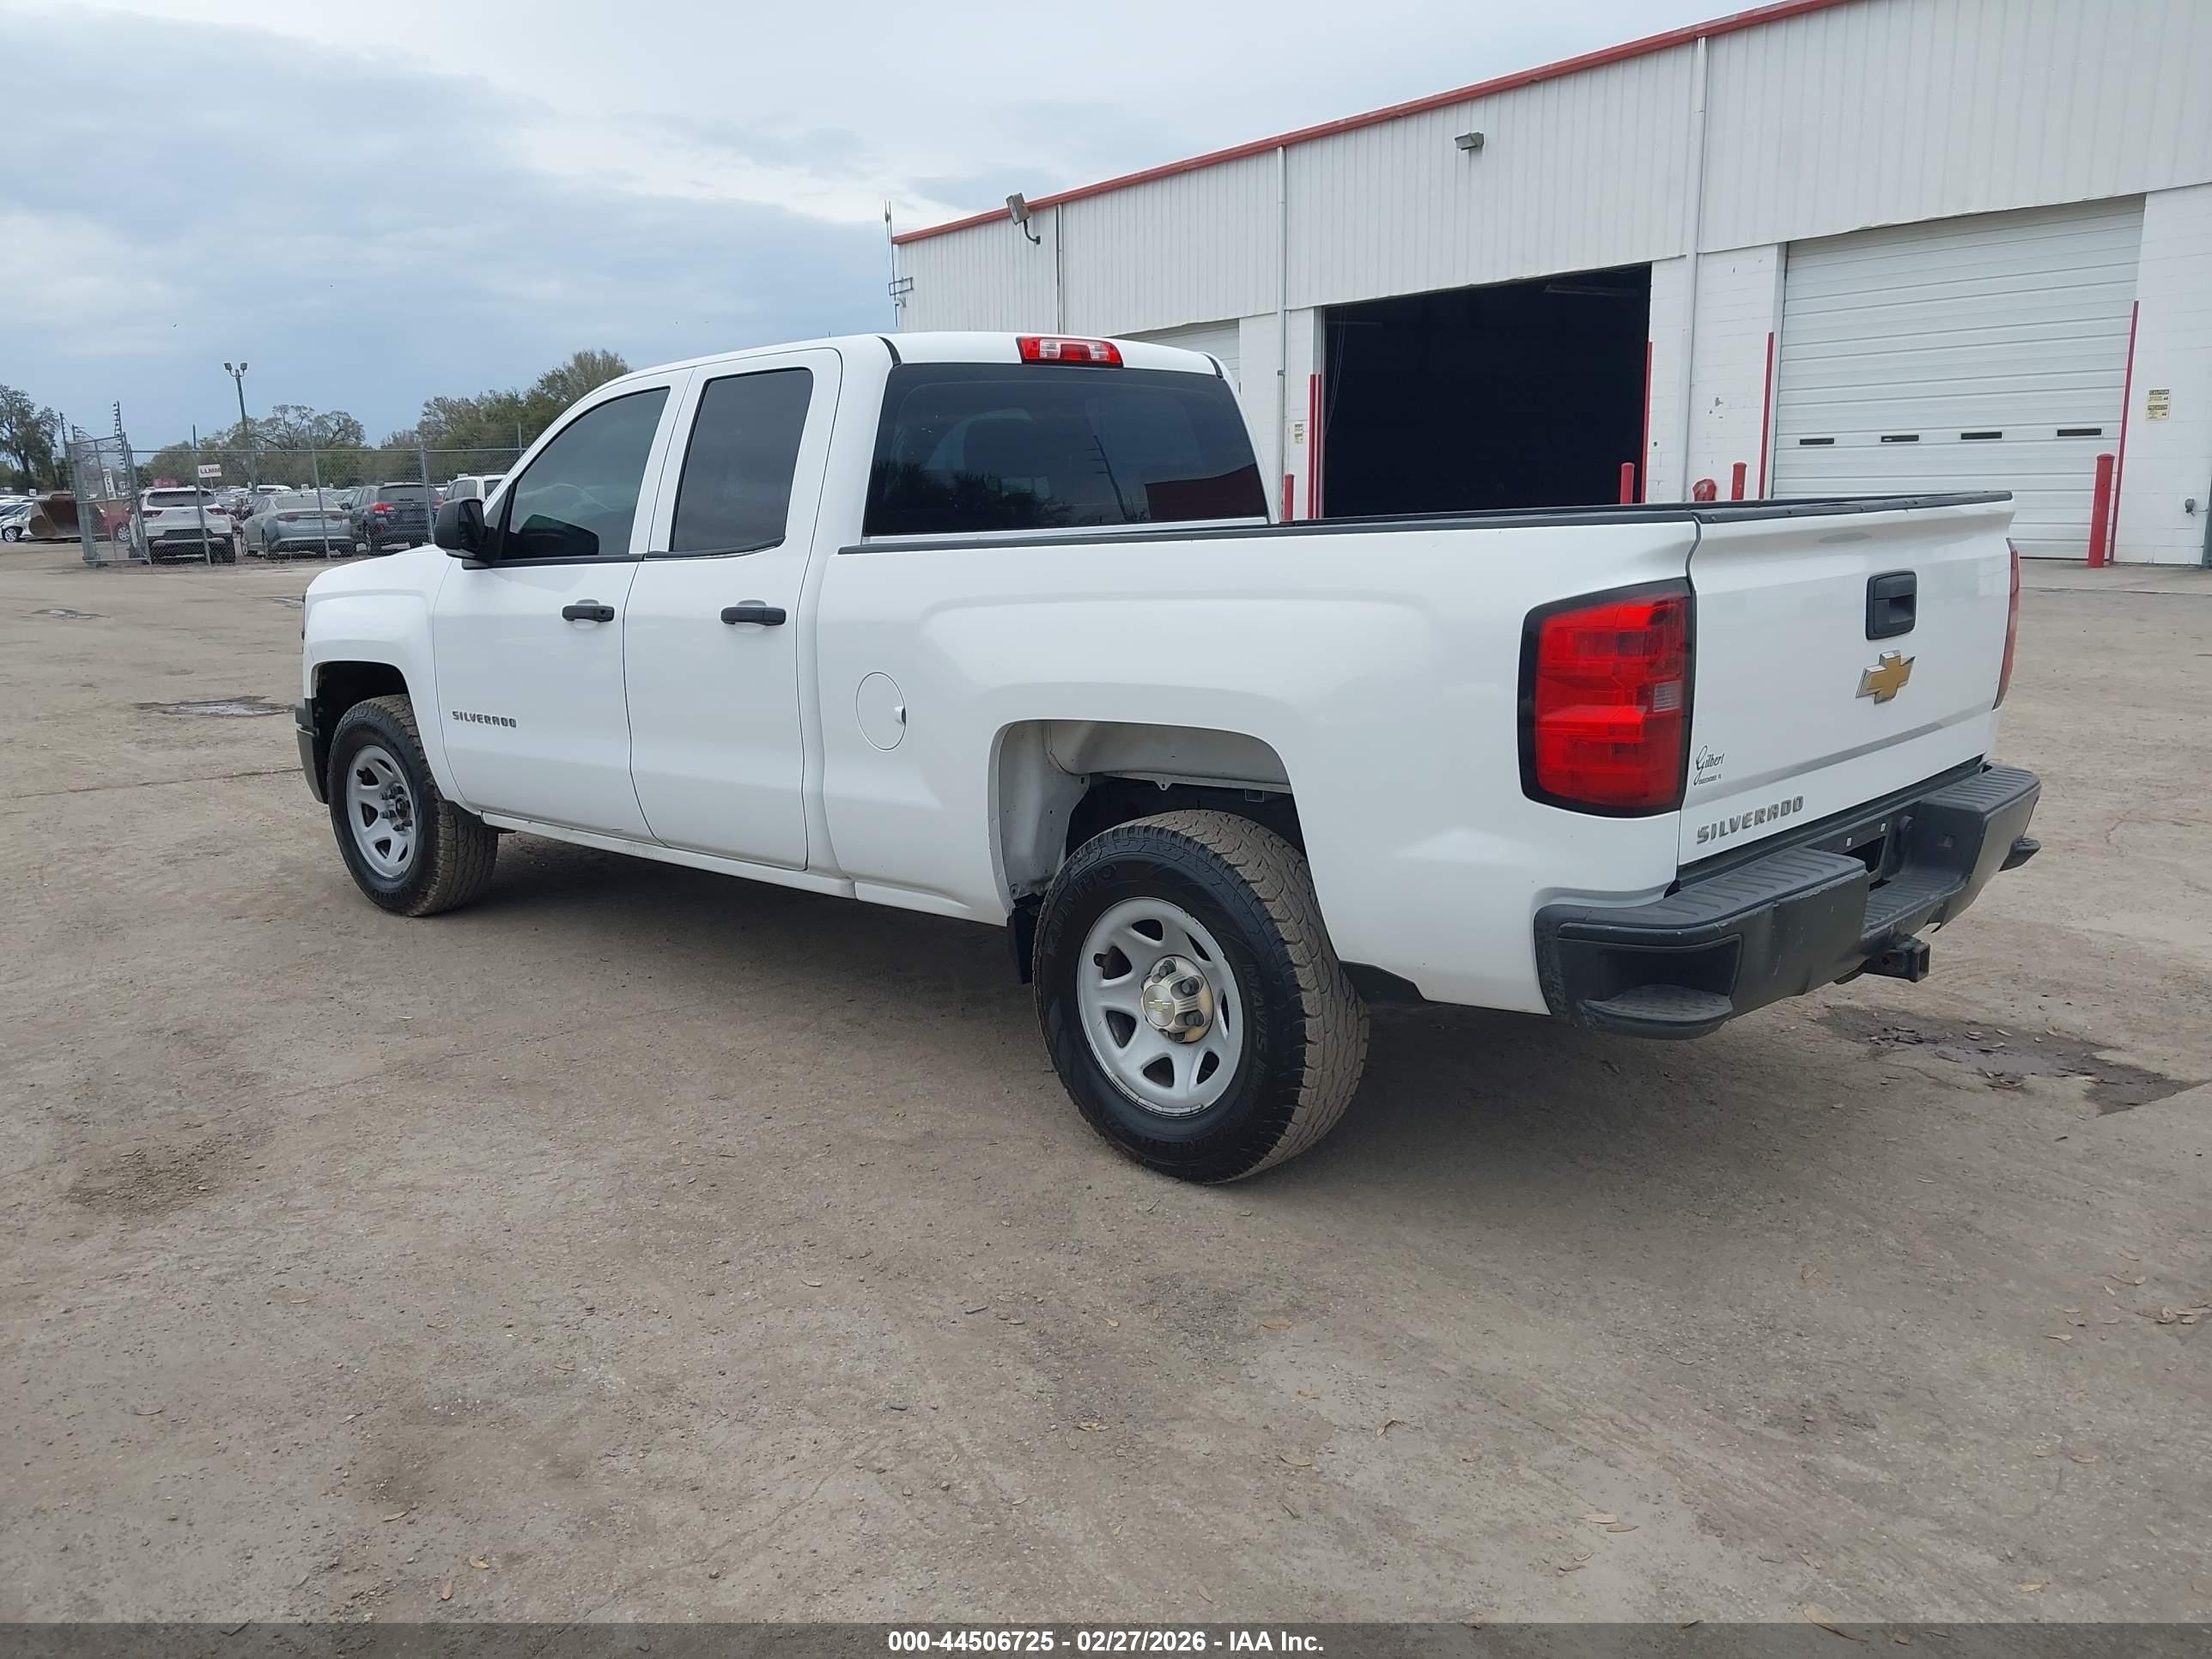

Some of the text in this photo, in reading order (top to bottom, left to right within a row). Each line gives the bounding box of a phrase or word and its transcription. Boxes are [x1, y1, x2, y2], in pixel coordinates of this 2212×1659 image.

[452, 710, 517, 728] SILVERADO
[1693, 744, 1725, 786] Gilbert
[1697, 795, 1804, 845] SILVERADO
